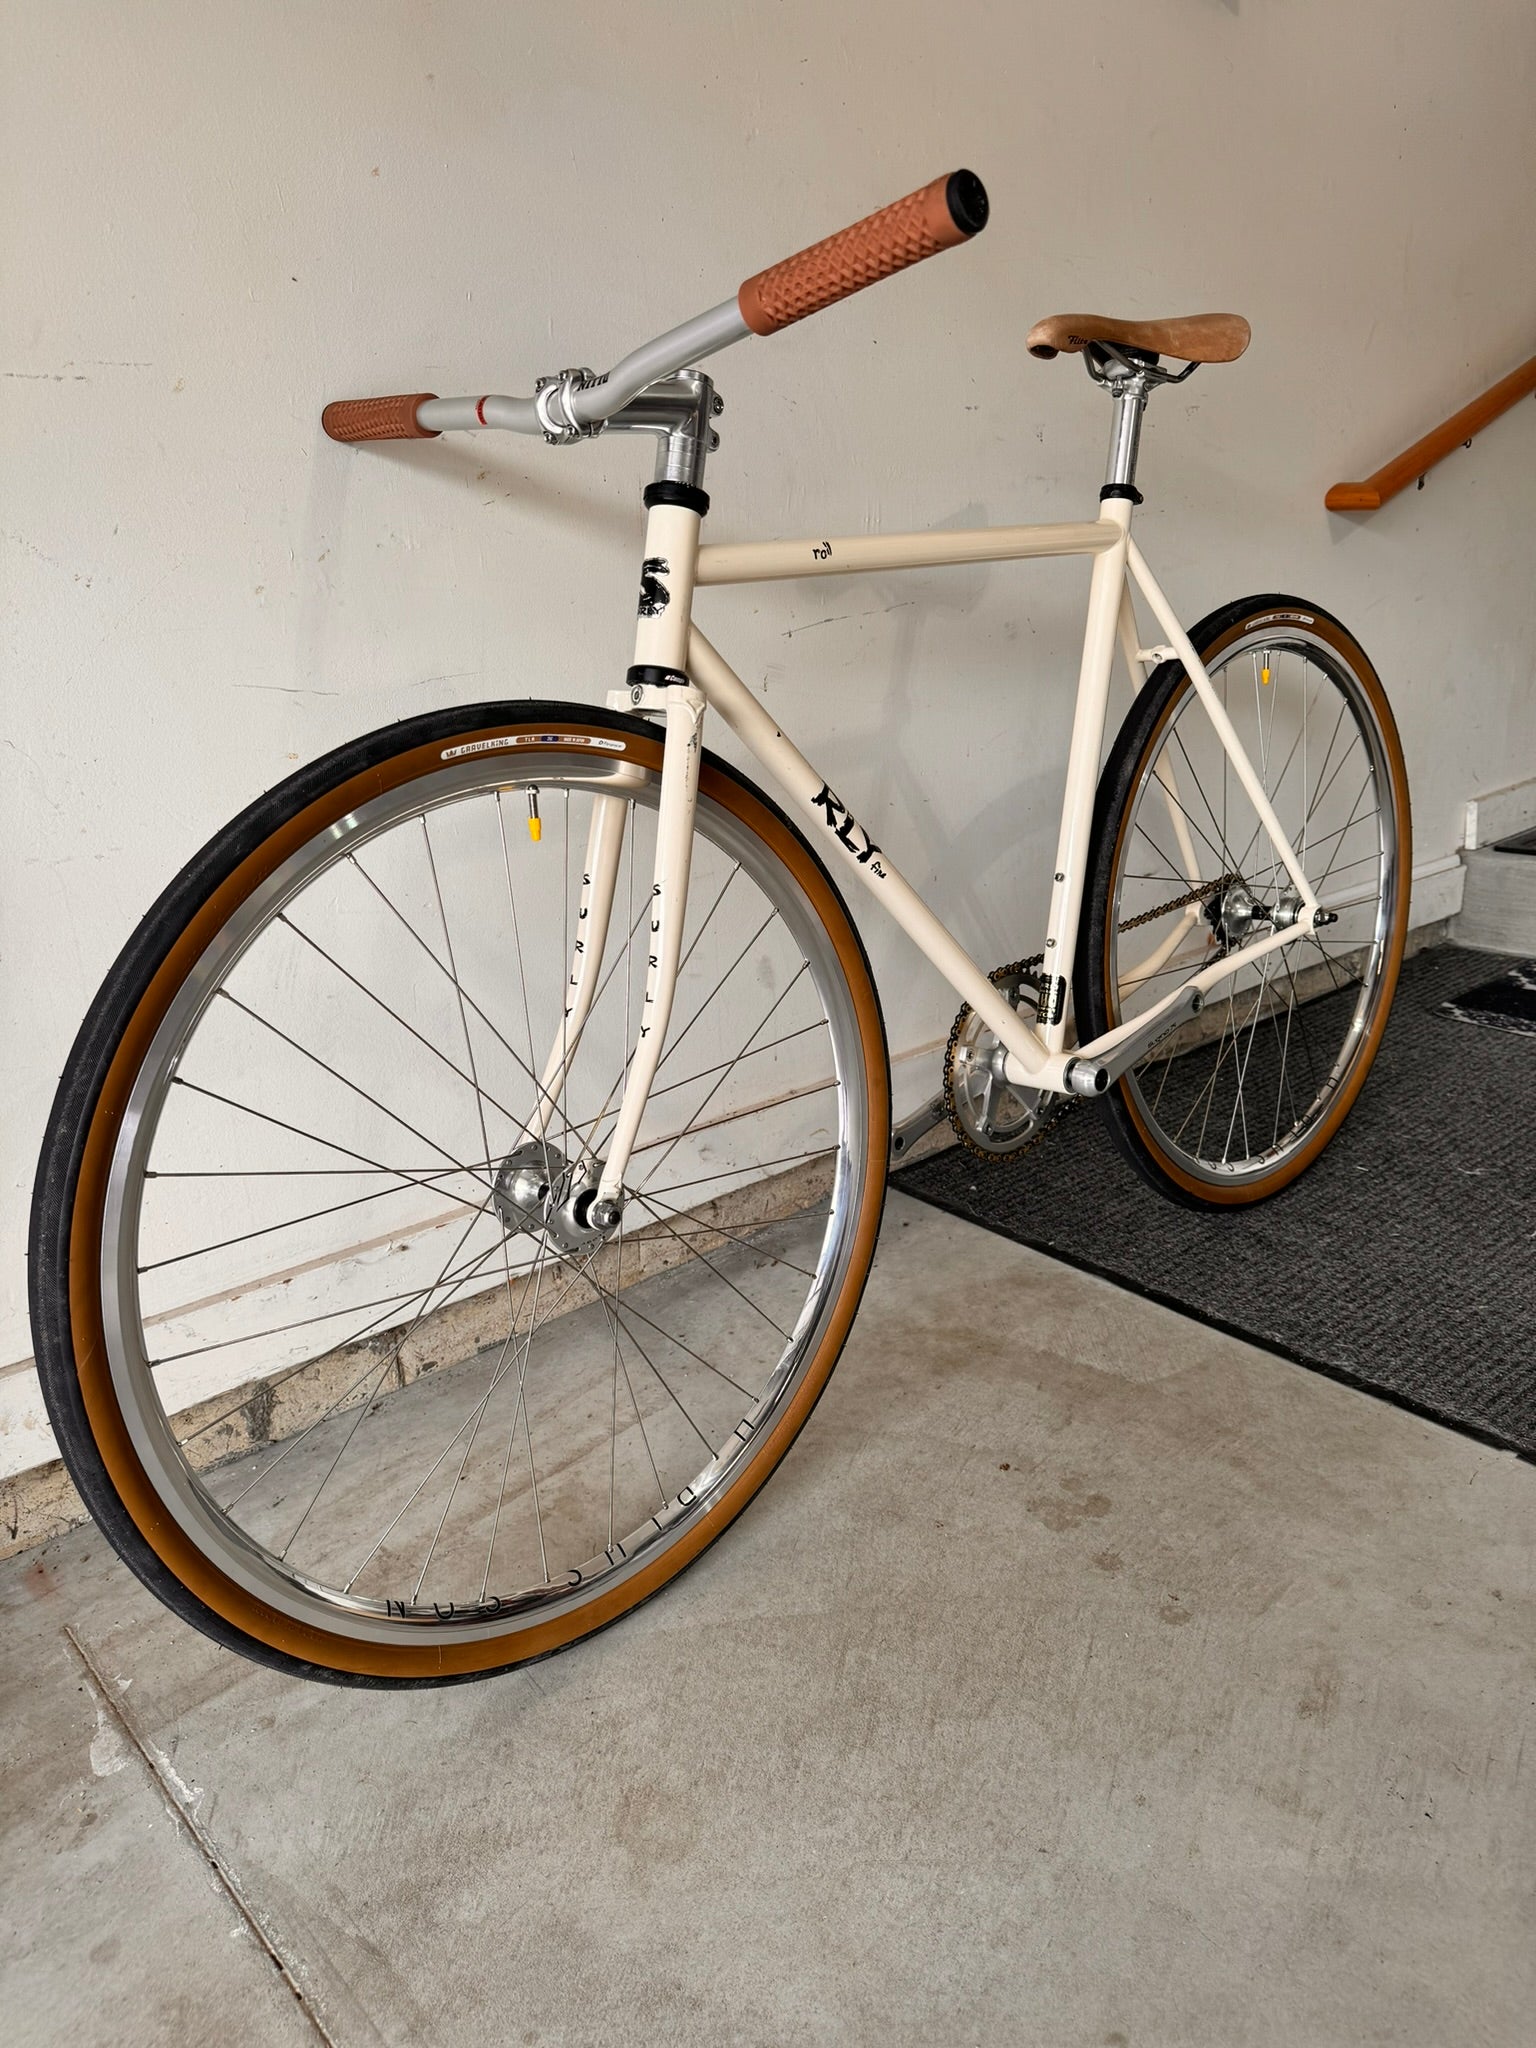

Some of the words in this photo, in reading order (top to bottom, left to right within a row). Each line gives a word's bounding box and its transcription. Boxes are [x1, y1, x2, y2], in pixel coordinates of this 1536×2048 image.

[460, 738, 509, 754] GRAVELKING
[564, 873, 591, 1018] SURLY
[640, 884, 662, 1038] SURLY
